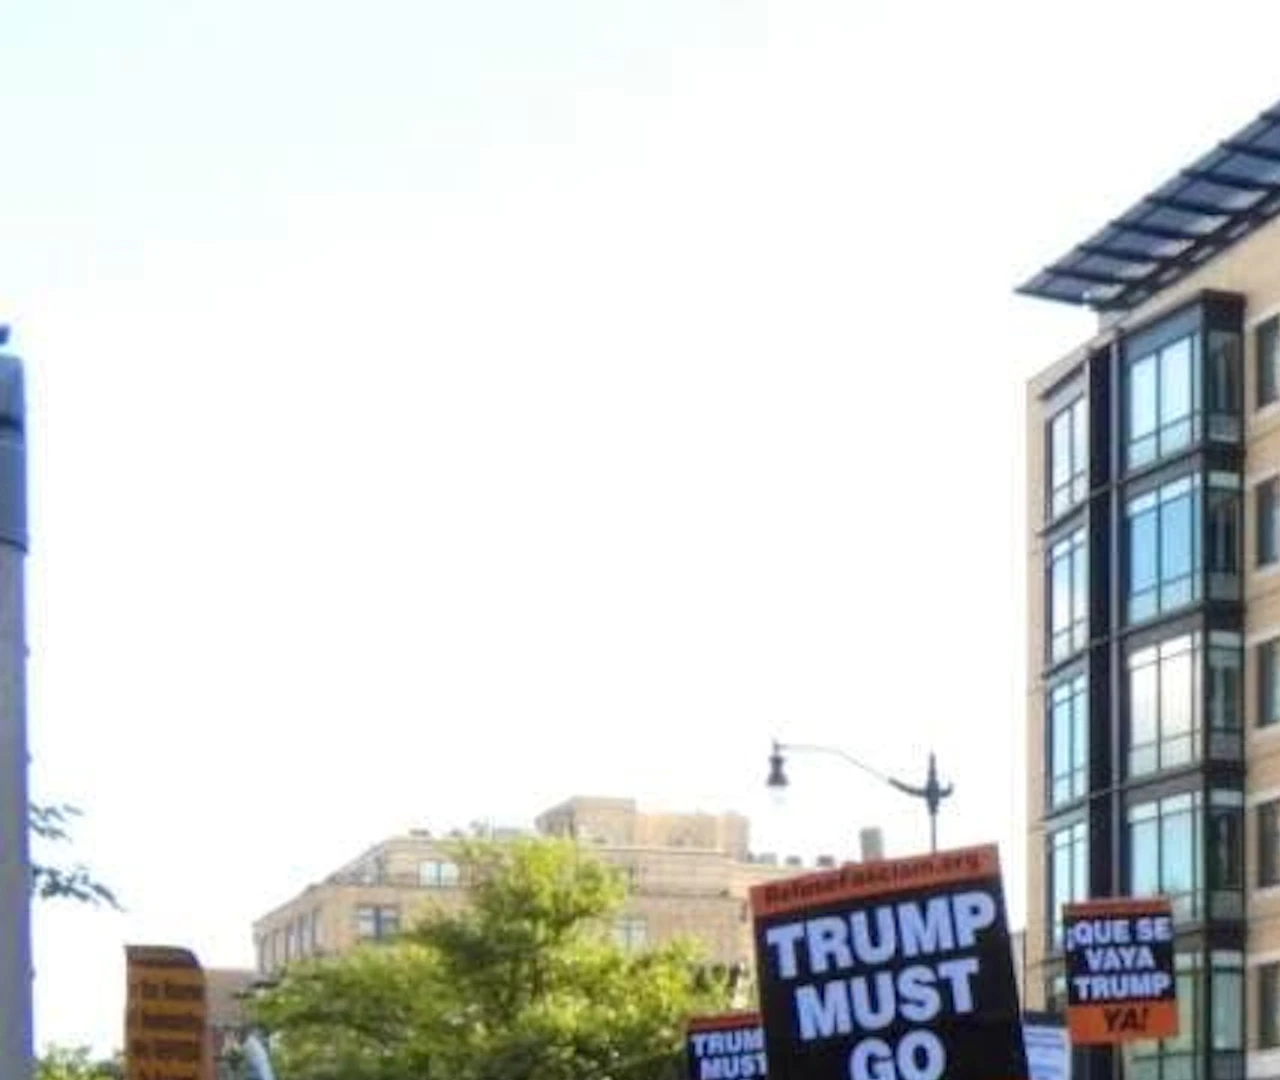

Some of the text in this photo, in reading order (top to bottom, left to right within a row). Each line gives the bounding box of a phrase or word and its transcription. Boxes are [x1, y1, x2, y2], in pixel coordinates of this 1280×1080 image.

[766, 889, 997, 980] TRUMP
[1135, 916, 1173, 942] SE
[1085, 946, 1155, 972] VAYA
[793, 957, 981, 1041] MUST
[1072, 972, 1173, 1001] TRUMP
[1102, 1006, 1150, 1033] YA!
[690, 1028, 766, 1057] TRUM
